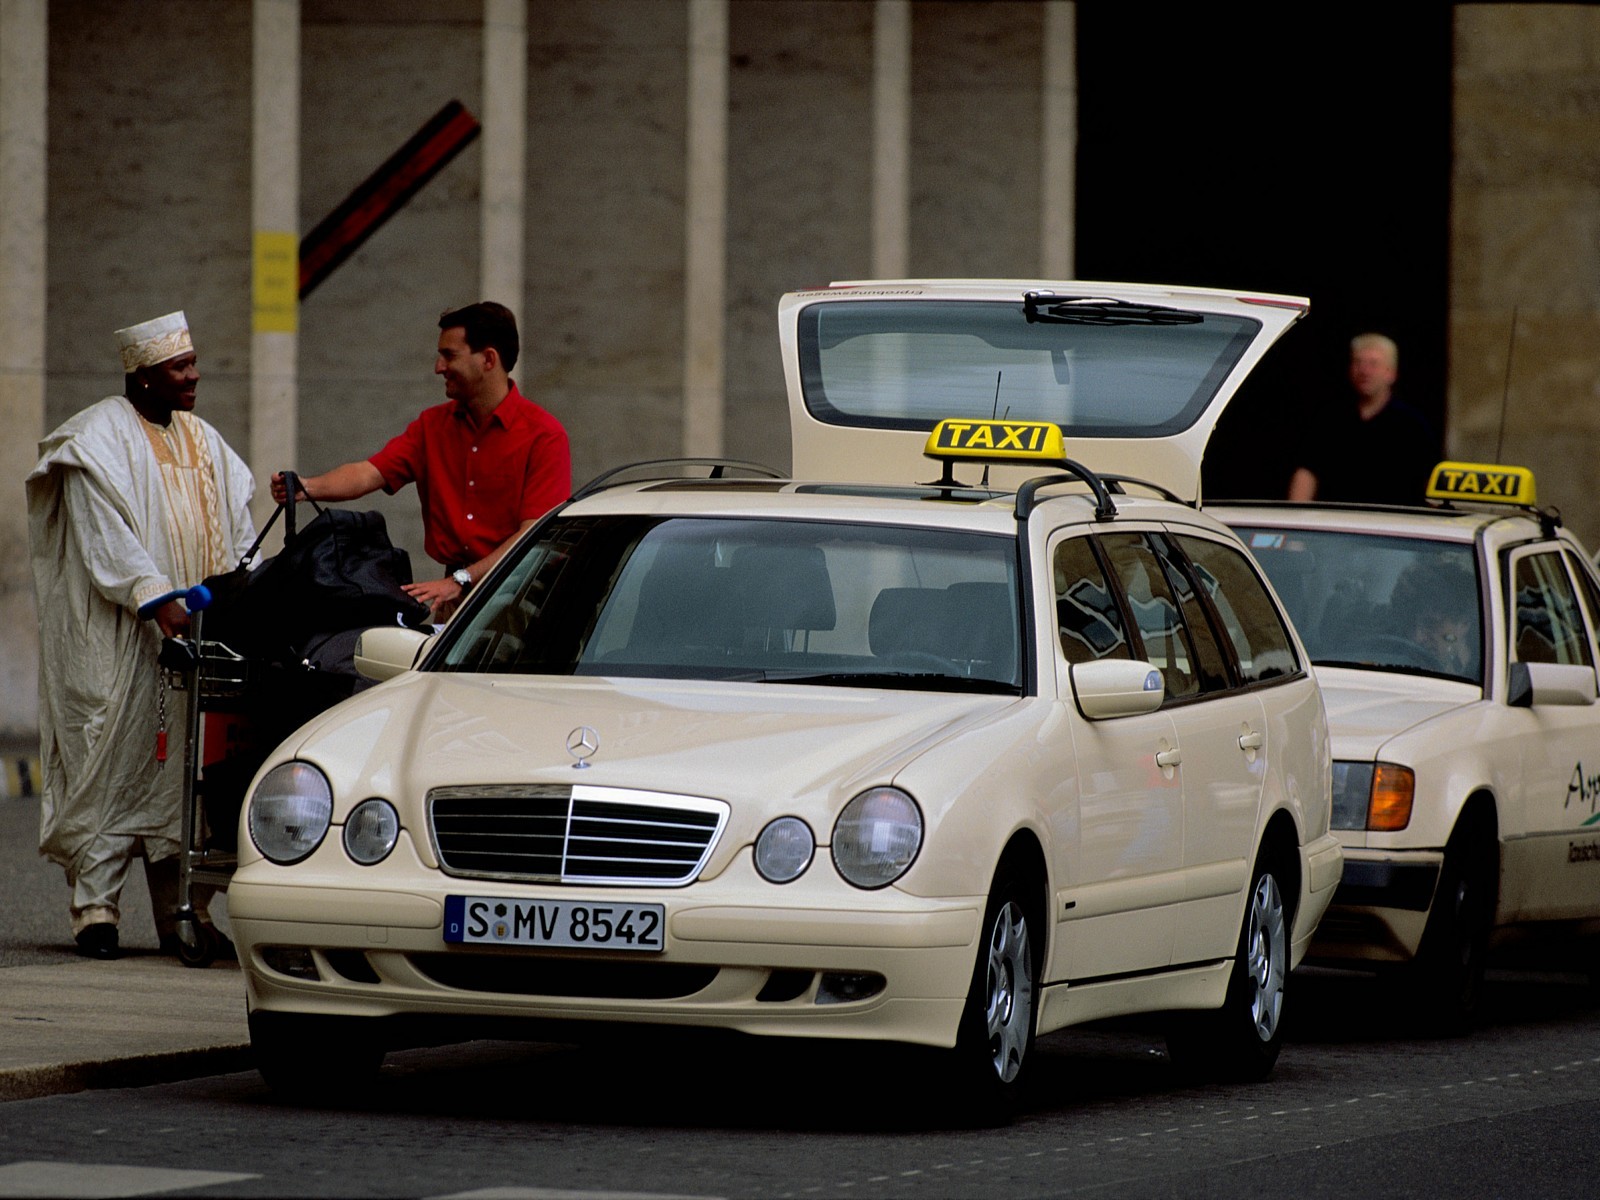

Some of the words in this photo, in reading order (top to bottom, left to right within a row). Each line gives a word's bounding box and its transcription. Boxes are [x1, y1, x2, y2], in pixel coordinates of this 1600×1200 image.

[796, 289, 924, 298] Erprobungswagen
[947, 424, 1042, 450] TAXI
[1443, 471, 1516, 495] TAXI
[450, 922, 459, 933] D
[467, 902, 489, 938] S
[513, 904, 560, 941] MV
[569, 907, 659, 945] 8542
